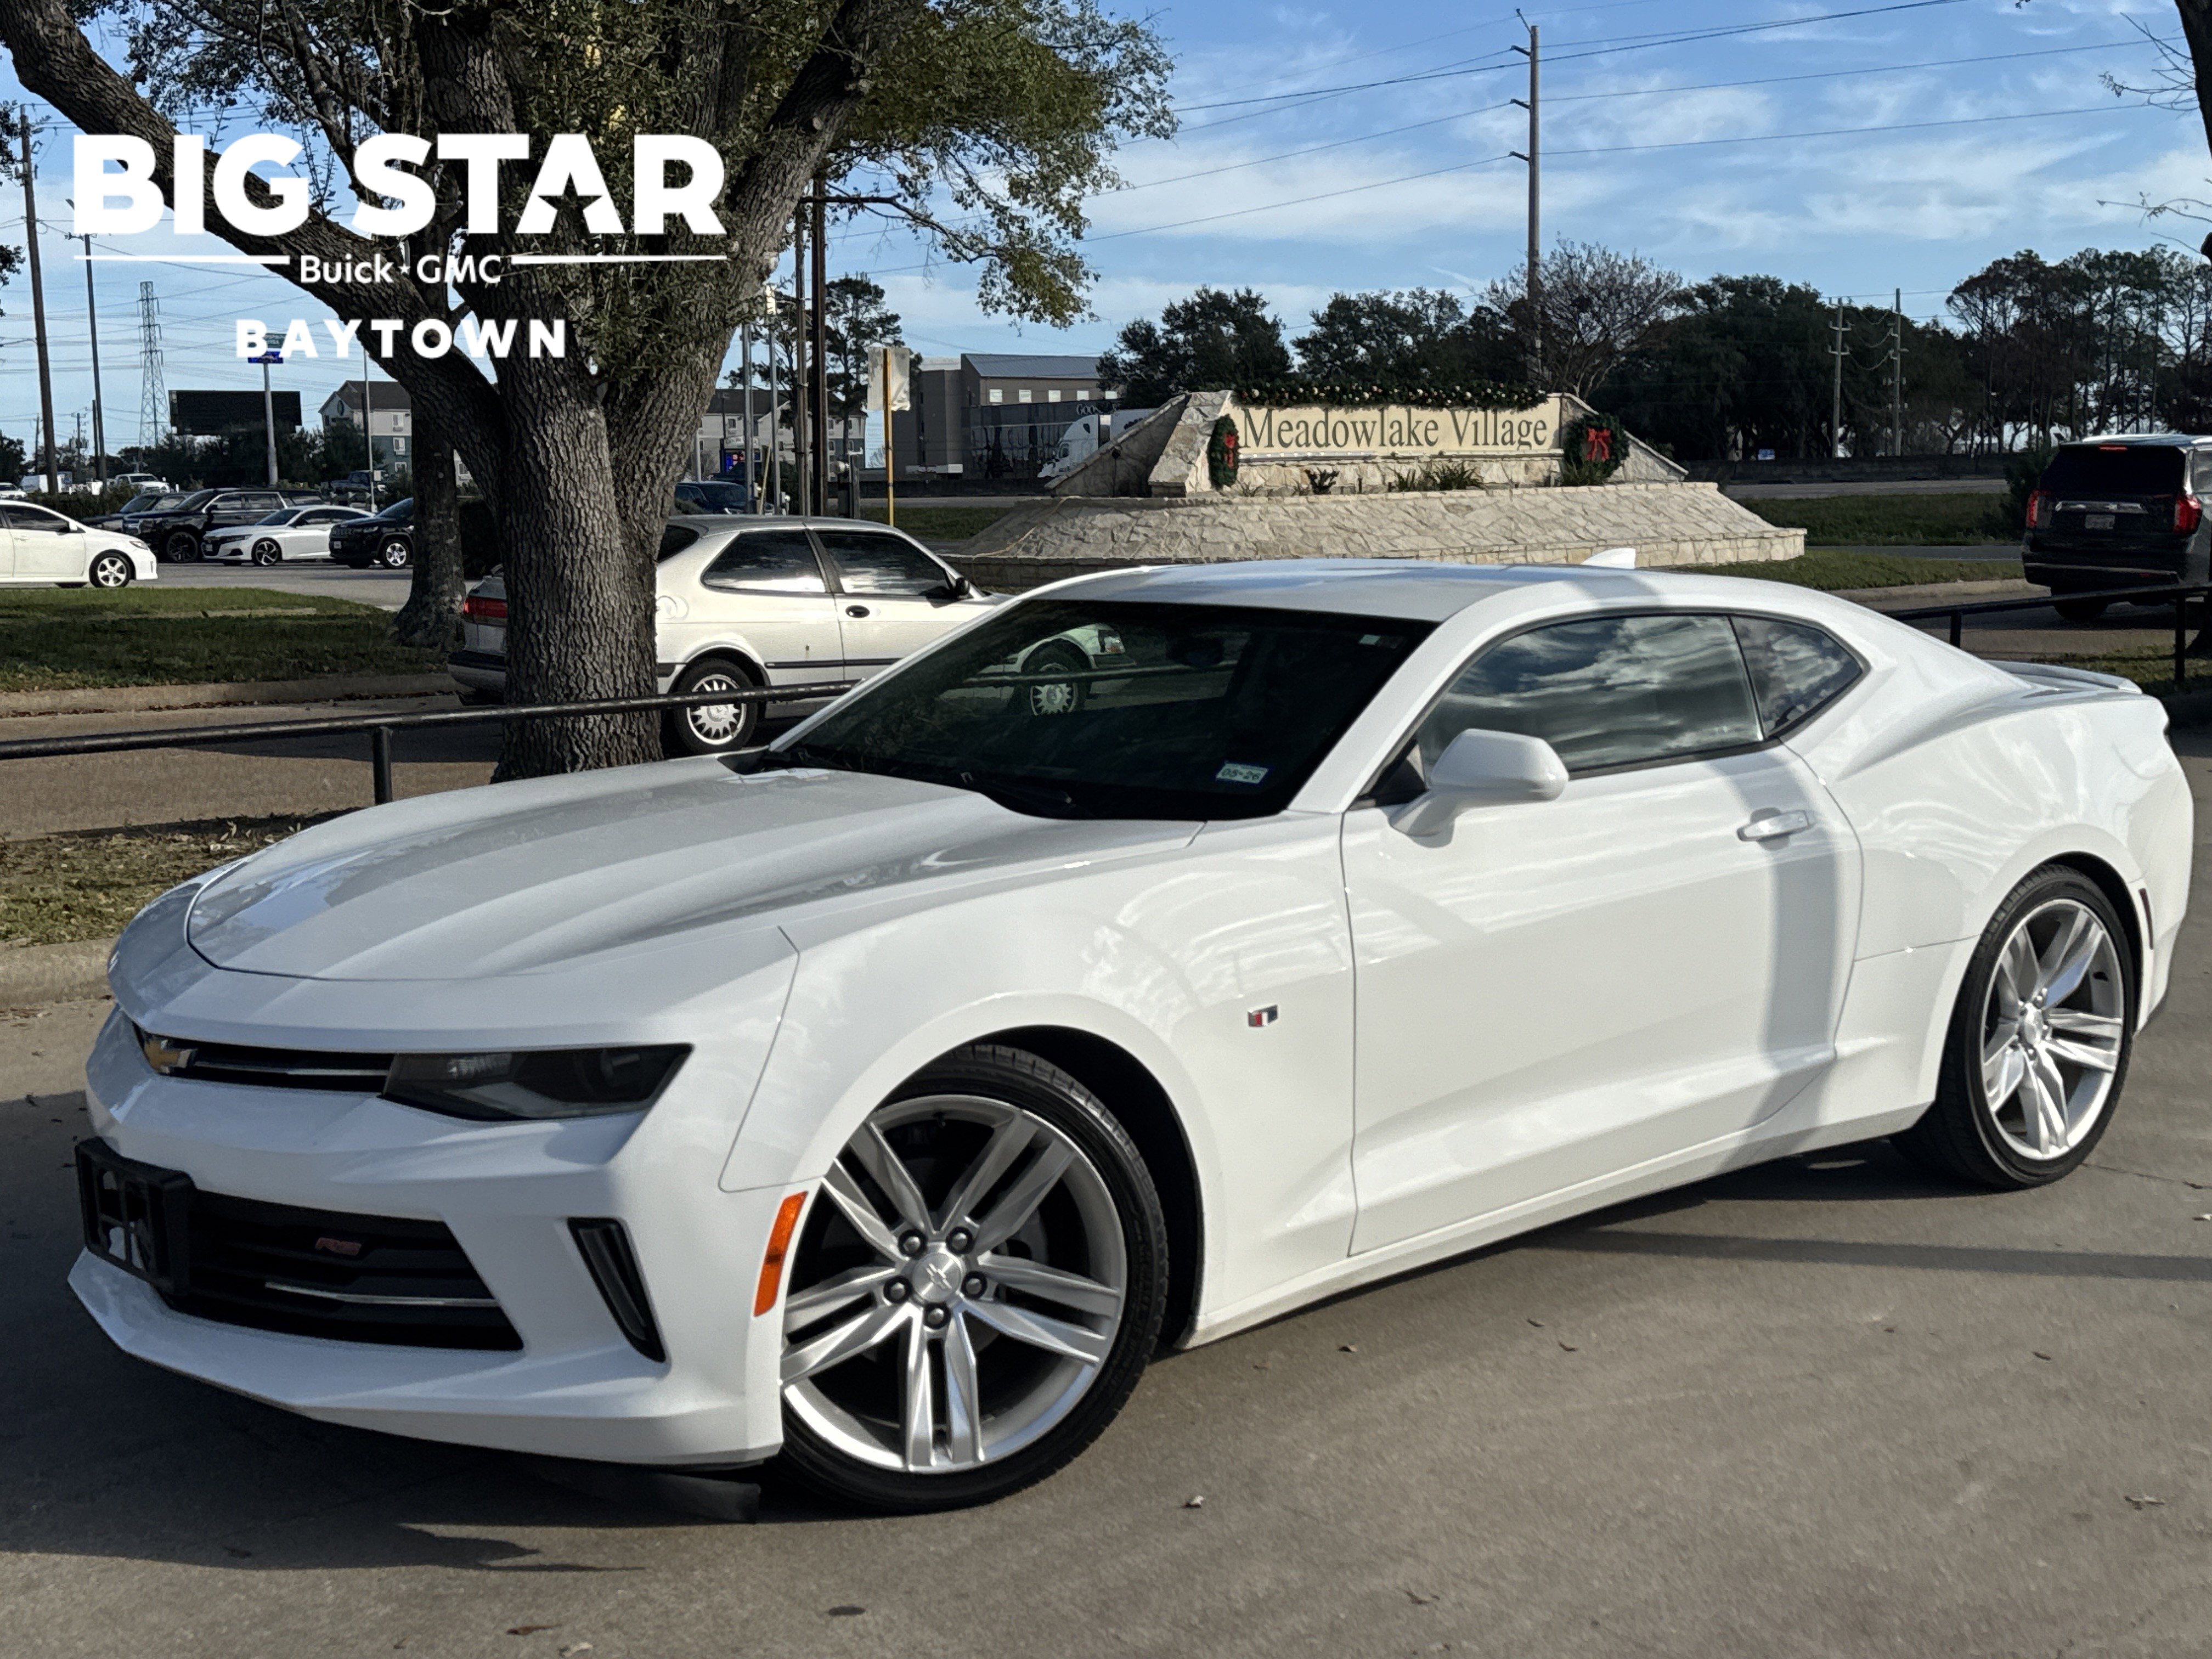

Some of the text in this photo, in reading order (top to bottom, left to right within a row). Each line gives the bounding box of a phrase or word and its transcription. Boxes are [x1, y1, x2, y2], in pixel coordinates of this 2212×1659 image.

[1241, 407, 1547, 450] Meadowlake Village
[315, 1237, 362, 1256] RS
